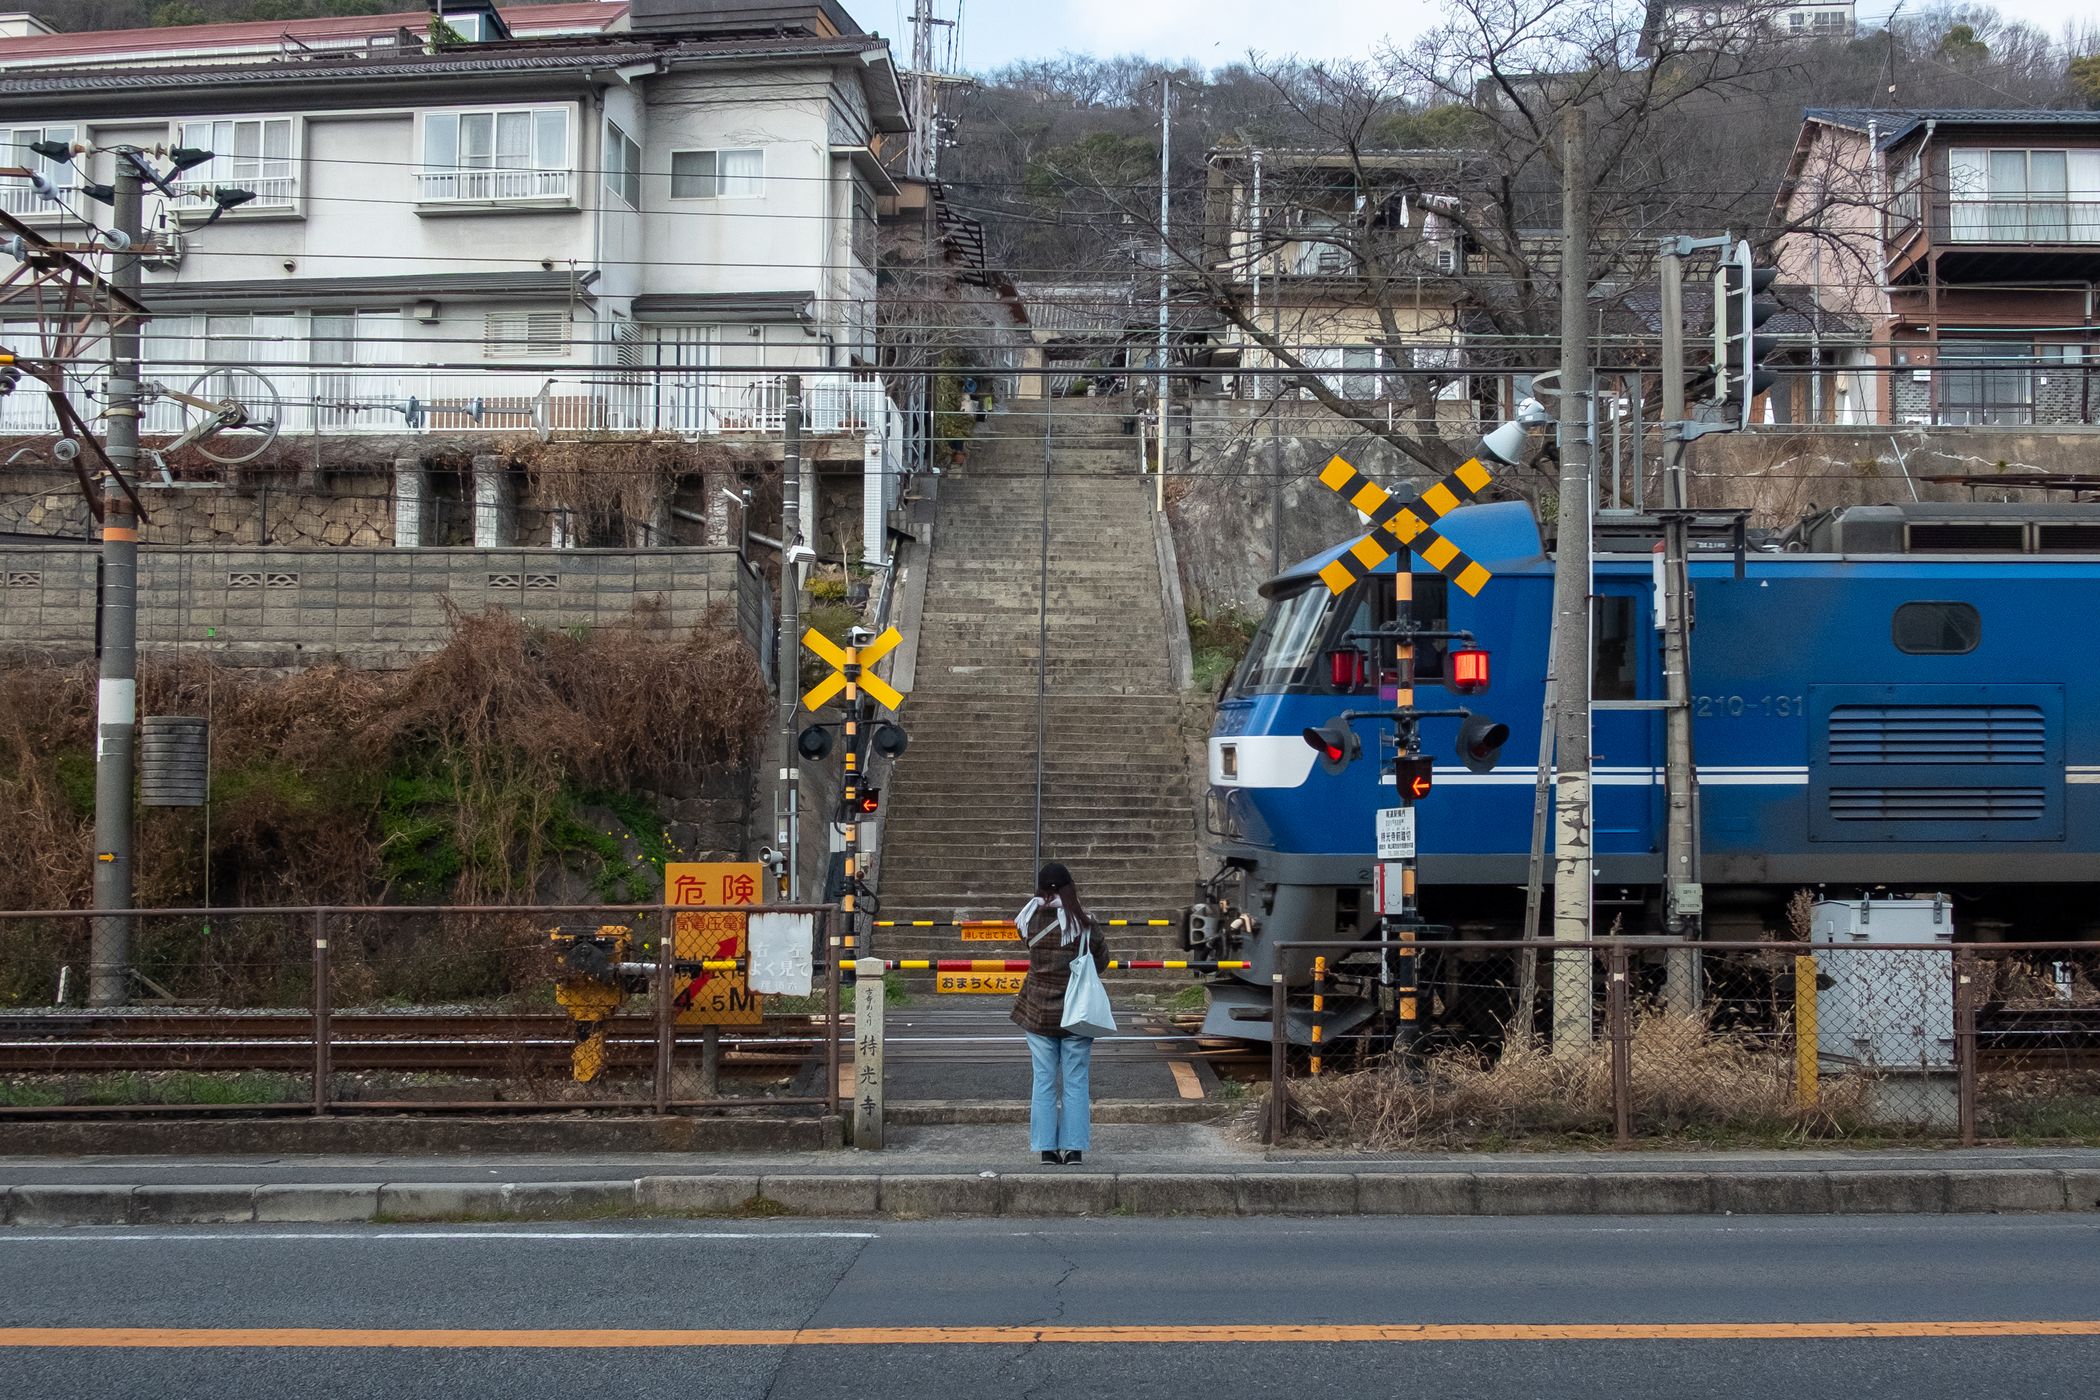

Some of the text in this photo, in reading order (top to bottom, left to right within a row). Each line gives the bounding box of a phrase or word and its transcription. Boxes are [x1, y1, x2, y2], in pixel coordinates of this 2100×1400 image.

[1692, 695, 1803, 717] 210-131
[674, 874, 754, 905] 危険
[749, 960, 809, 977] よく見て
[941, 977, 1021, 990] おまちくださ
[859, 1034, 878, 1117] 持光寺
